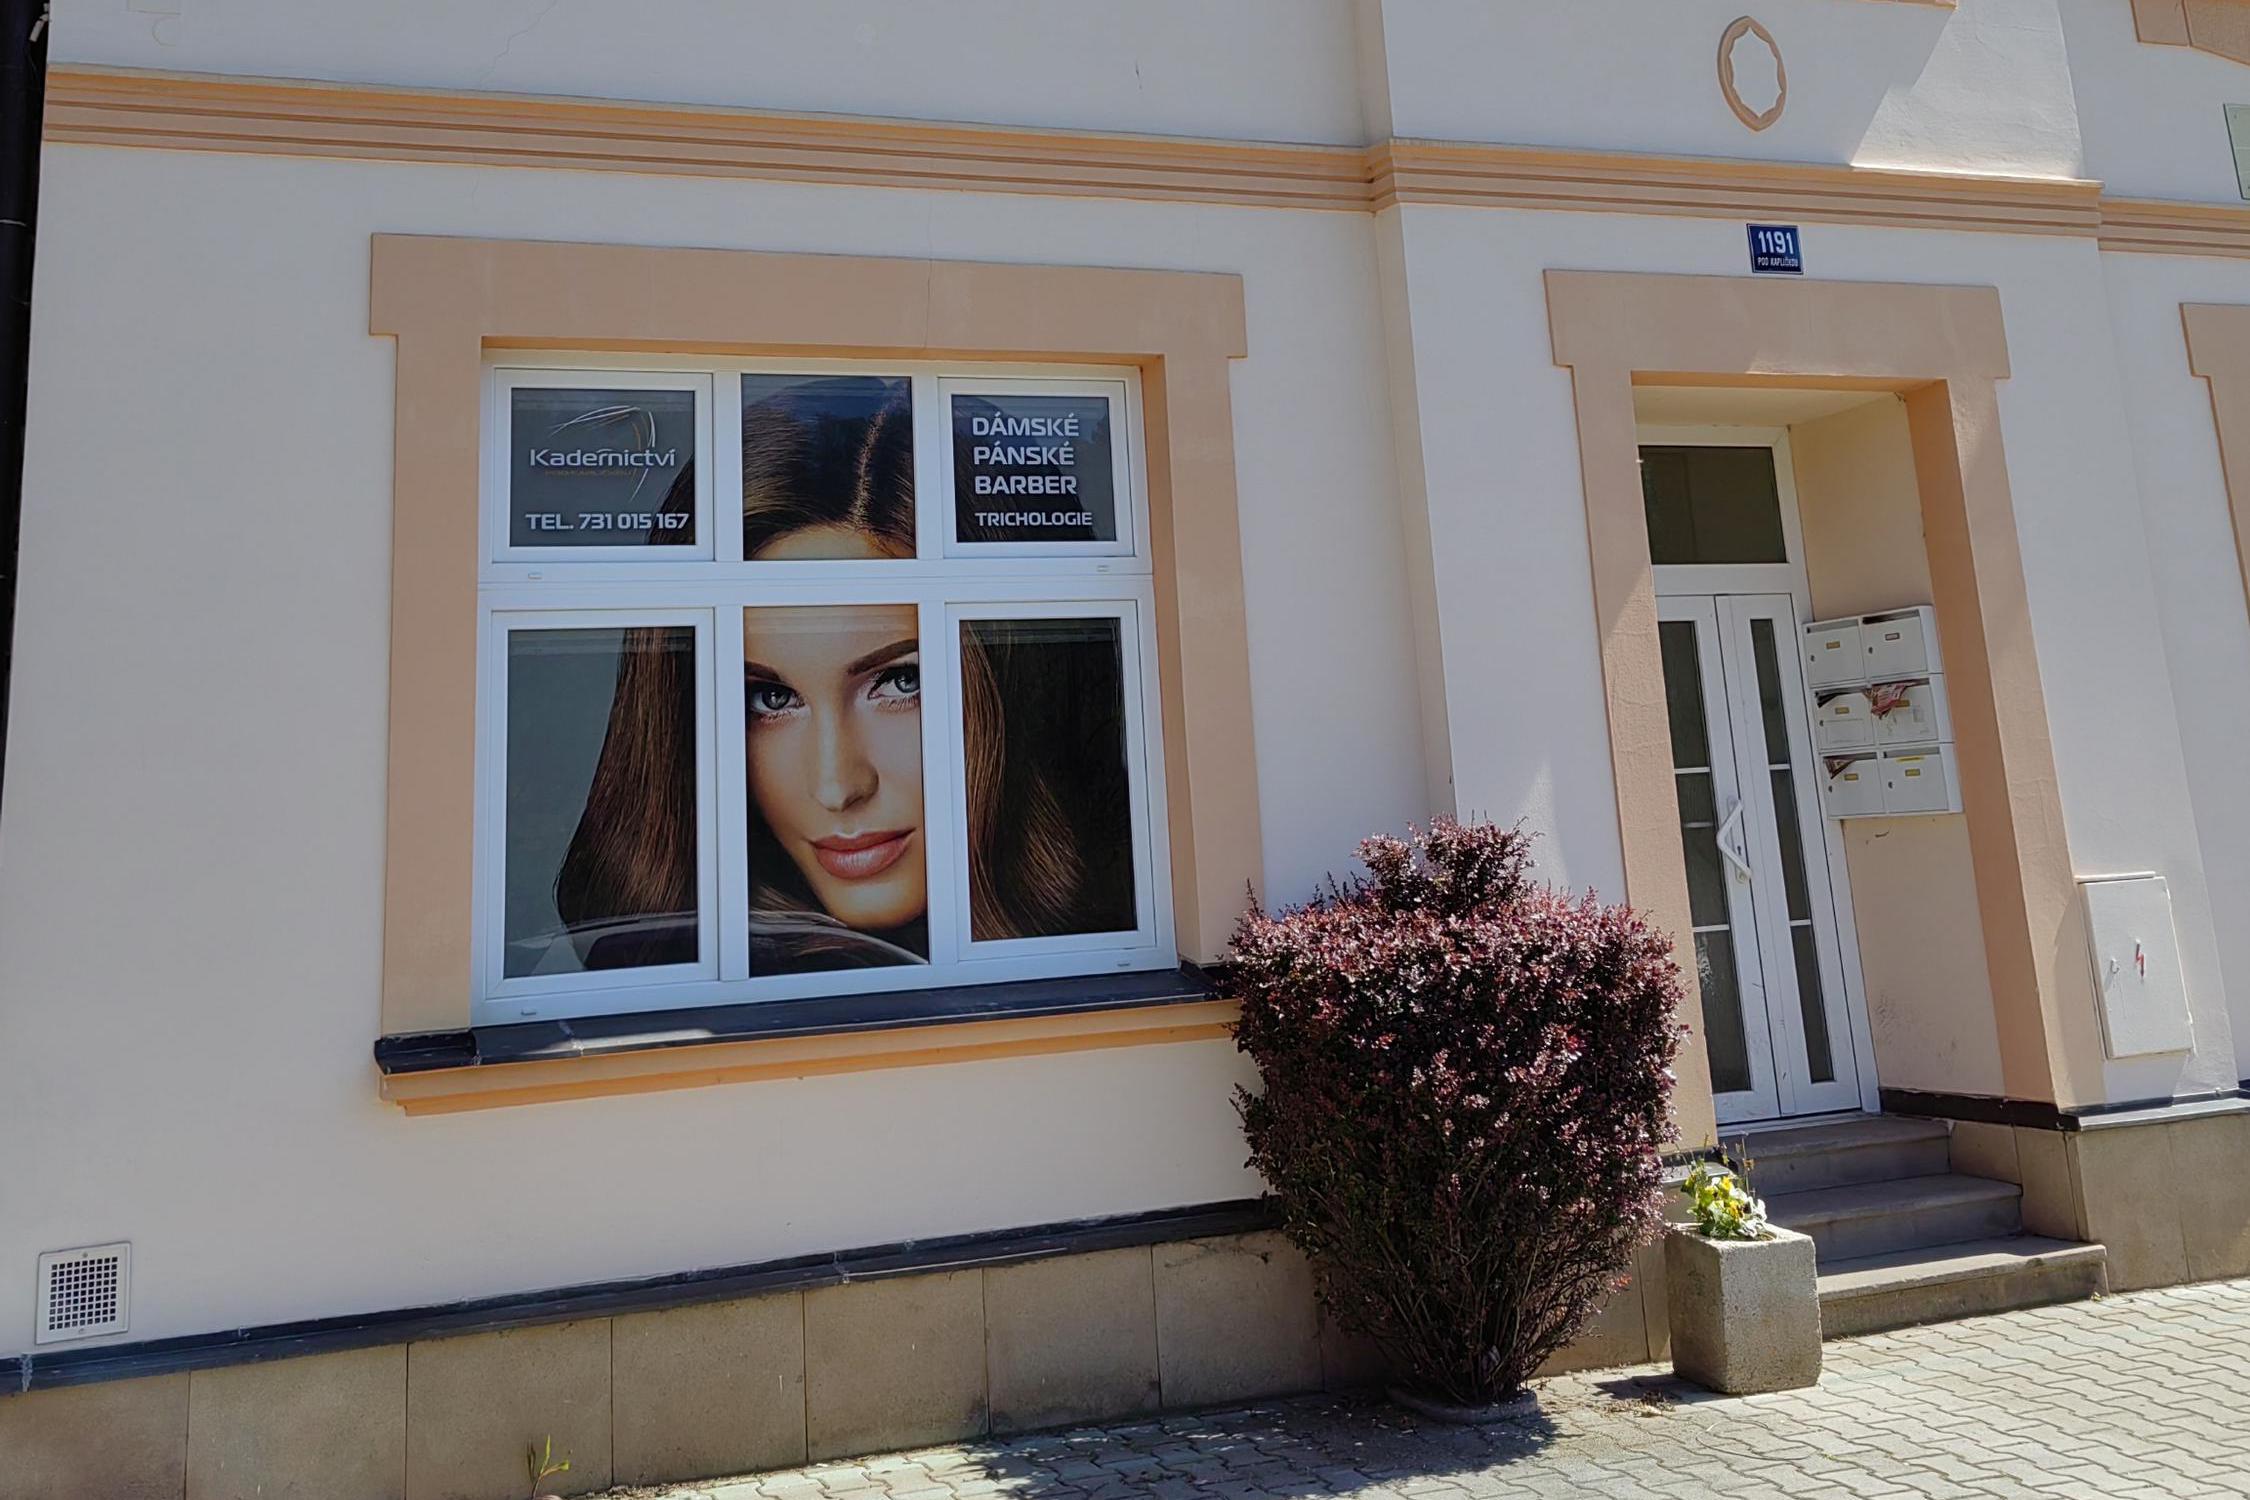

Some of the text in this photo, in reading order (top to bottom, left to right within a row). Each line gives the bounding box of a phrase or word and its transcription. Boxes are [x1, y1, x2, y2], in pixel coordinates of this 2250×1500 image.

[1758, 230, 1794, 254] 1191
[1757, 256, 1769, 266] POD
[972, 411, 1079, 437] DÁMSKÉ
[973, 440, 1075, 465] PÁNSKÉ
[974, 475, 1078, 495] BARBER
[525, 512, 690, 530] TEL. 731 015 167
[974, 511, 1093, 527] TRICHOLOGIE
